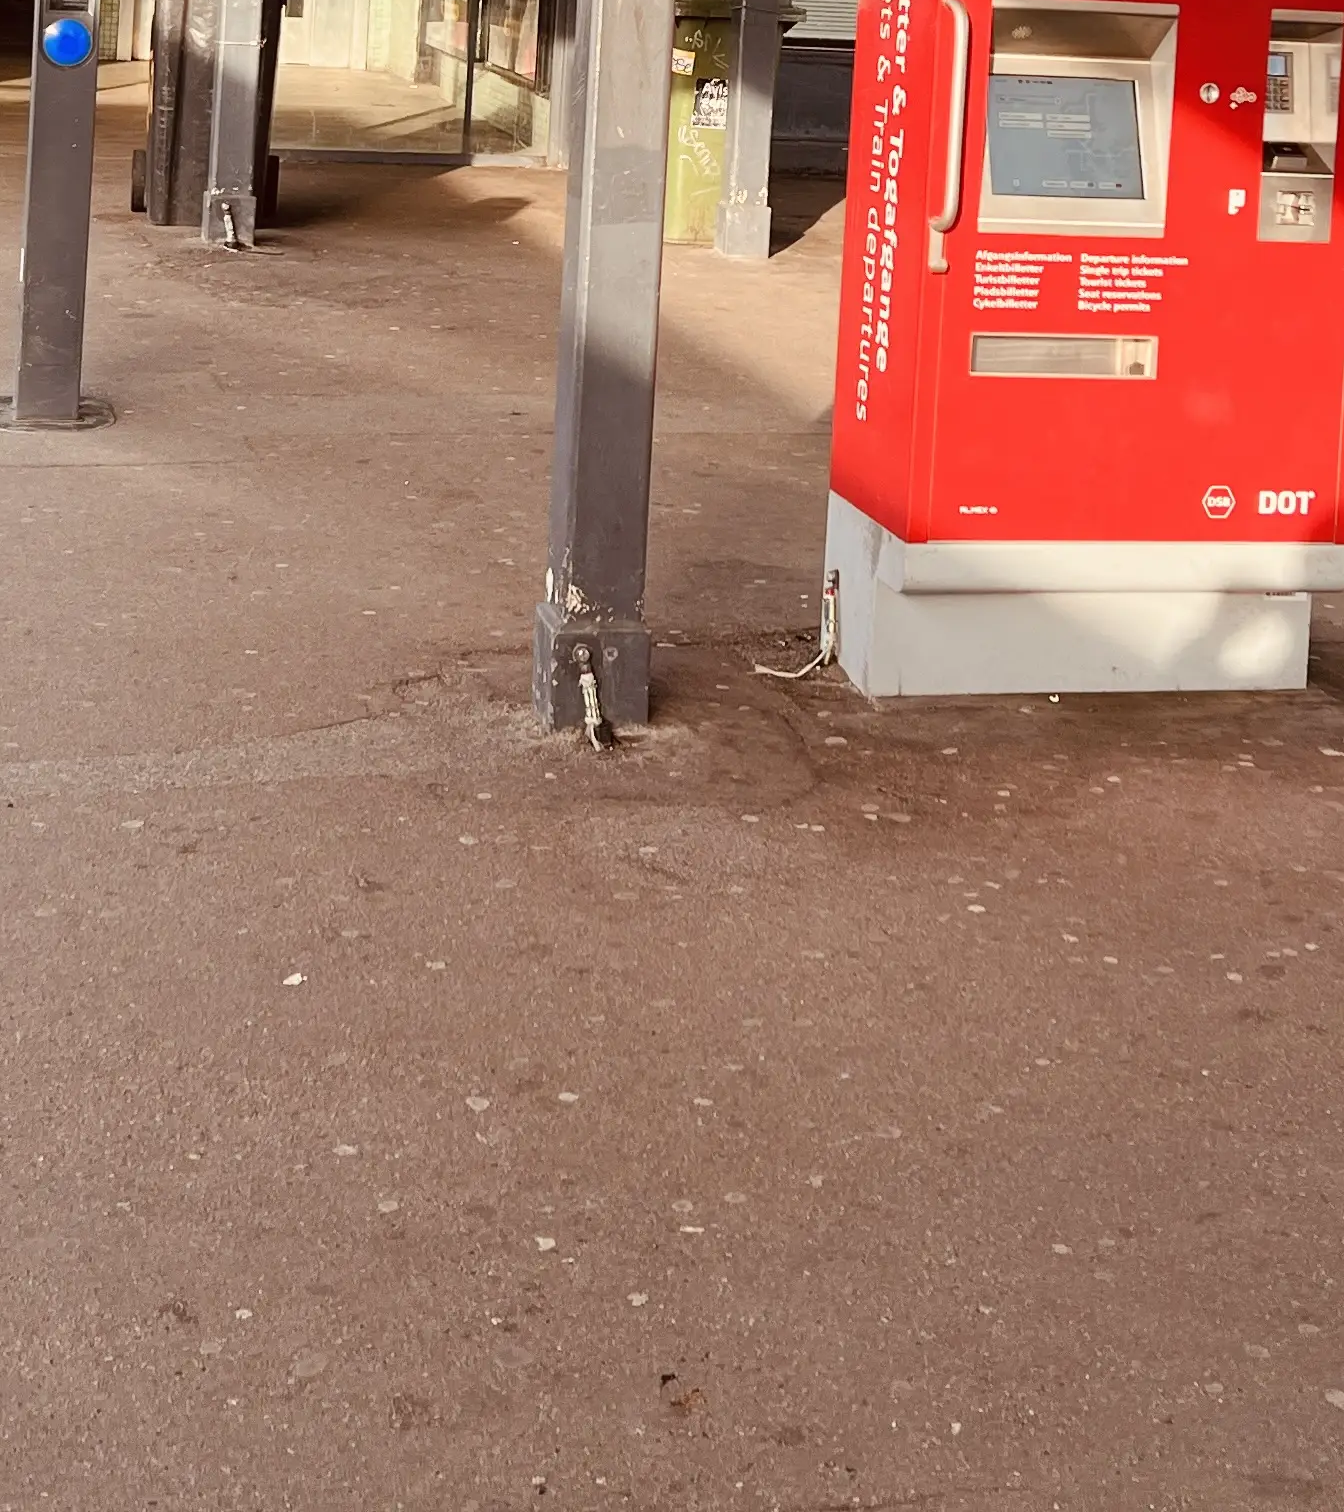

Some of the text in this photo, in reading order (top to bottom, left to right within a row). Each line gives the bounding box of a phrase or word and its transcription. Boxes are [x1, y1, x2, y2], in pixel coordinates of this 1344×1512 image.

[875, 54, 891, 83] &
[891, 84, 907, 117] &
[868, 99, 889, 193] Train
[875, 129, 905, 373] Togafgange
[855, 206, 882, 422] departures
[1257, 490, 1313, 515] DOT
